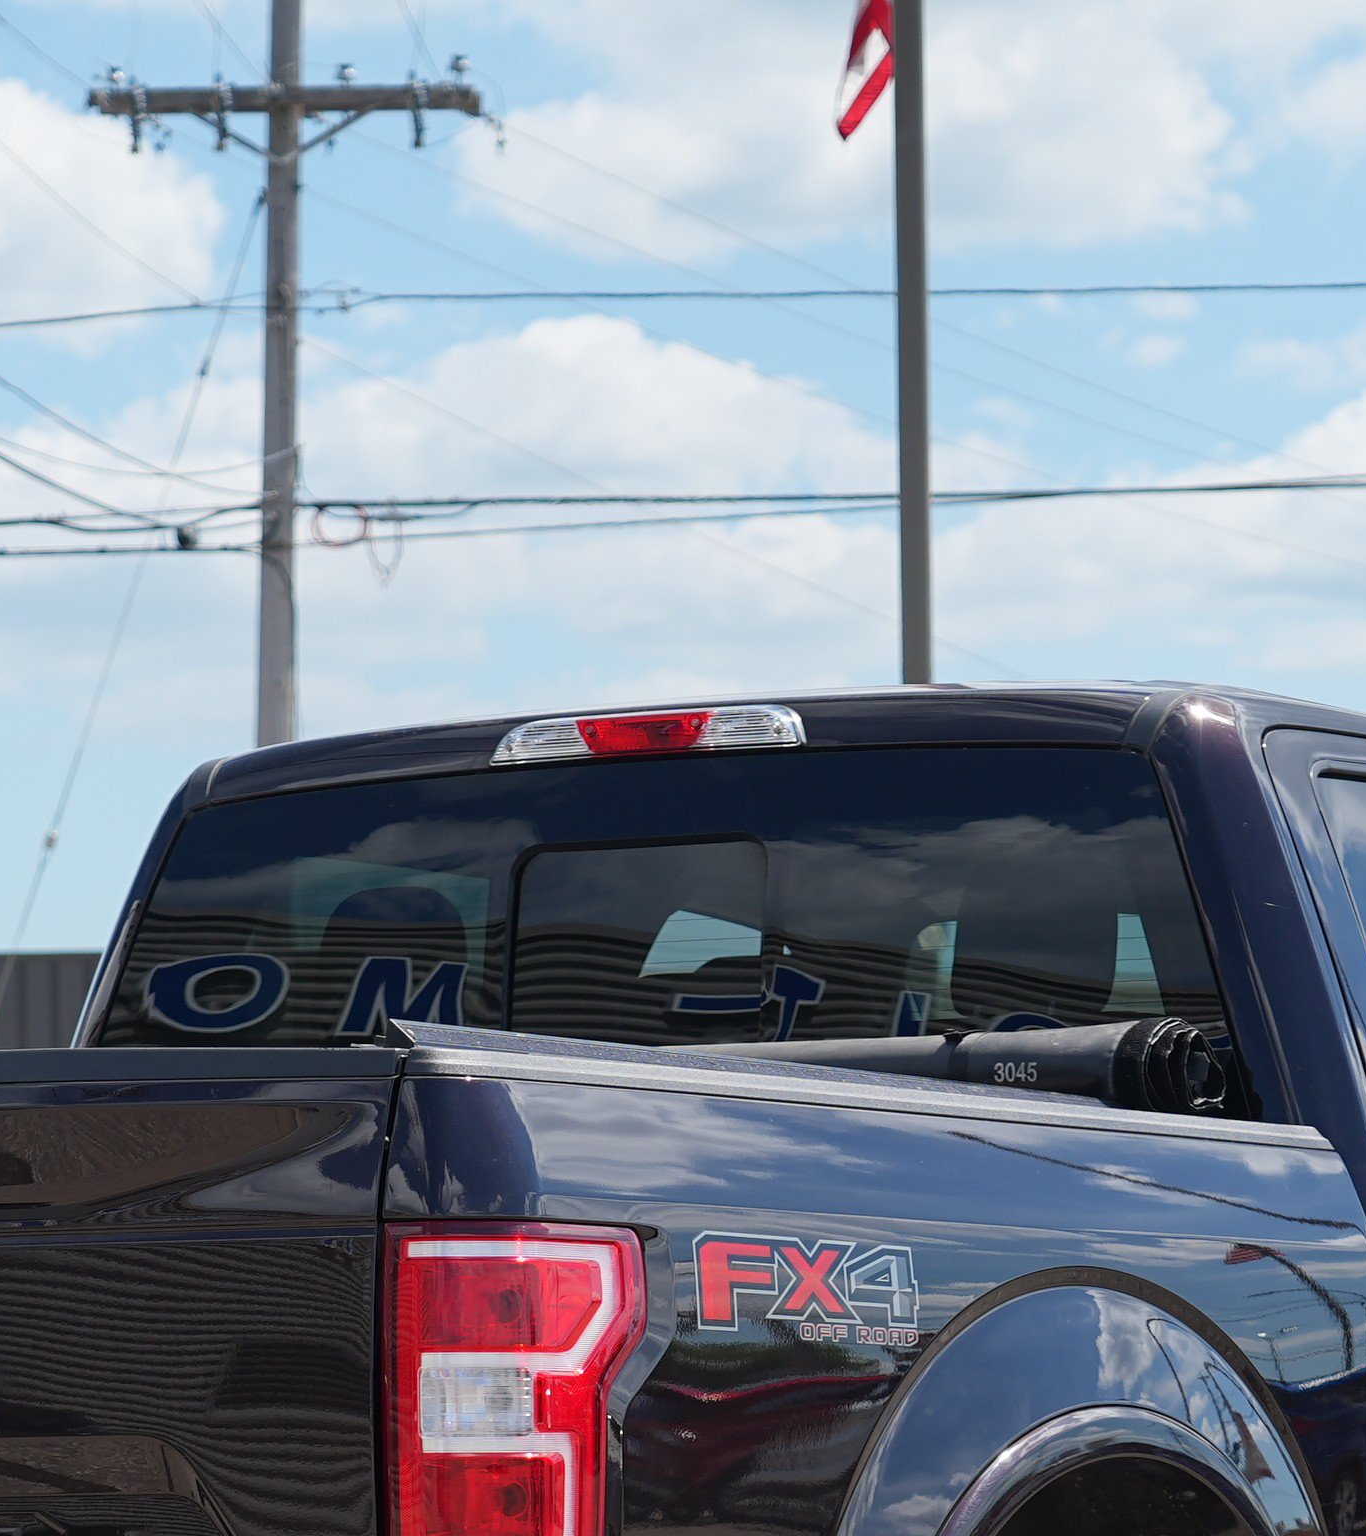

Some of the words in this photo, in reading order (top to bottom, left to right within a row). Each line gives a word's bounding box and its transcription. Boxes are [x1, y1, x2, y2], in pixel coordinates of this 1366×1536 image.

[994, 1062, 1037, 1082] 3045
[692, 1230, 919, 1331] FX4
[799, 1322, 848, 1342] OFF
[855, 1324, 919, 1347] ROAD
